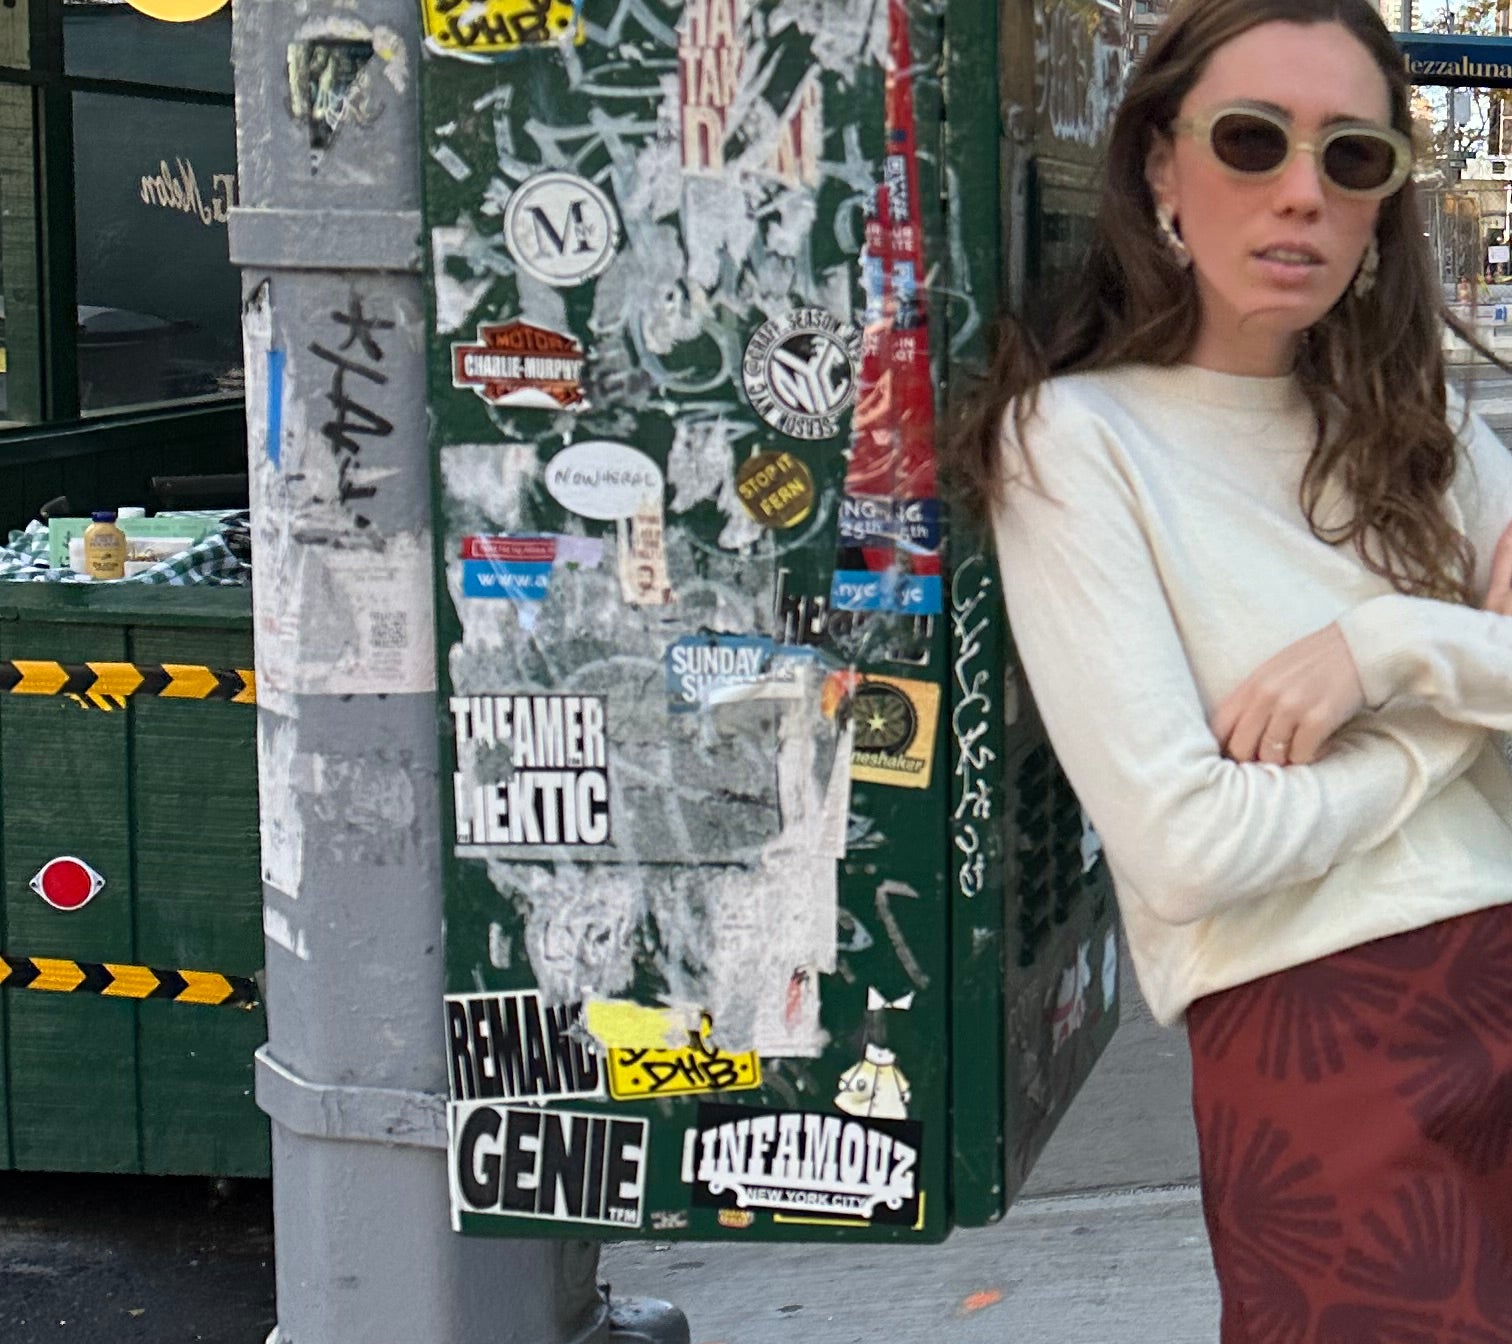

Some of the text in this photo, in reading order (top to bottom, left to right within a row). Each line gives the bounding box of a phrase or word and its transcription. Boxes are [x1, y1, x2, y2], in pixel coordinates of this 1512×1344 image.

[771, 336, 849, 415] NYC
[738, 452, 795, 500] STOP IT
[760, 478, 806, 516] FERN
[671, 645, 763, 675] SUNDAY
[457, 1106, 643, 1222] GENIE
[697, 1113, 918, 1199] INFAMOUZ
[748, 1188, 867, 1209] NEW YORK CITY
